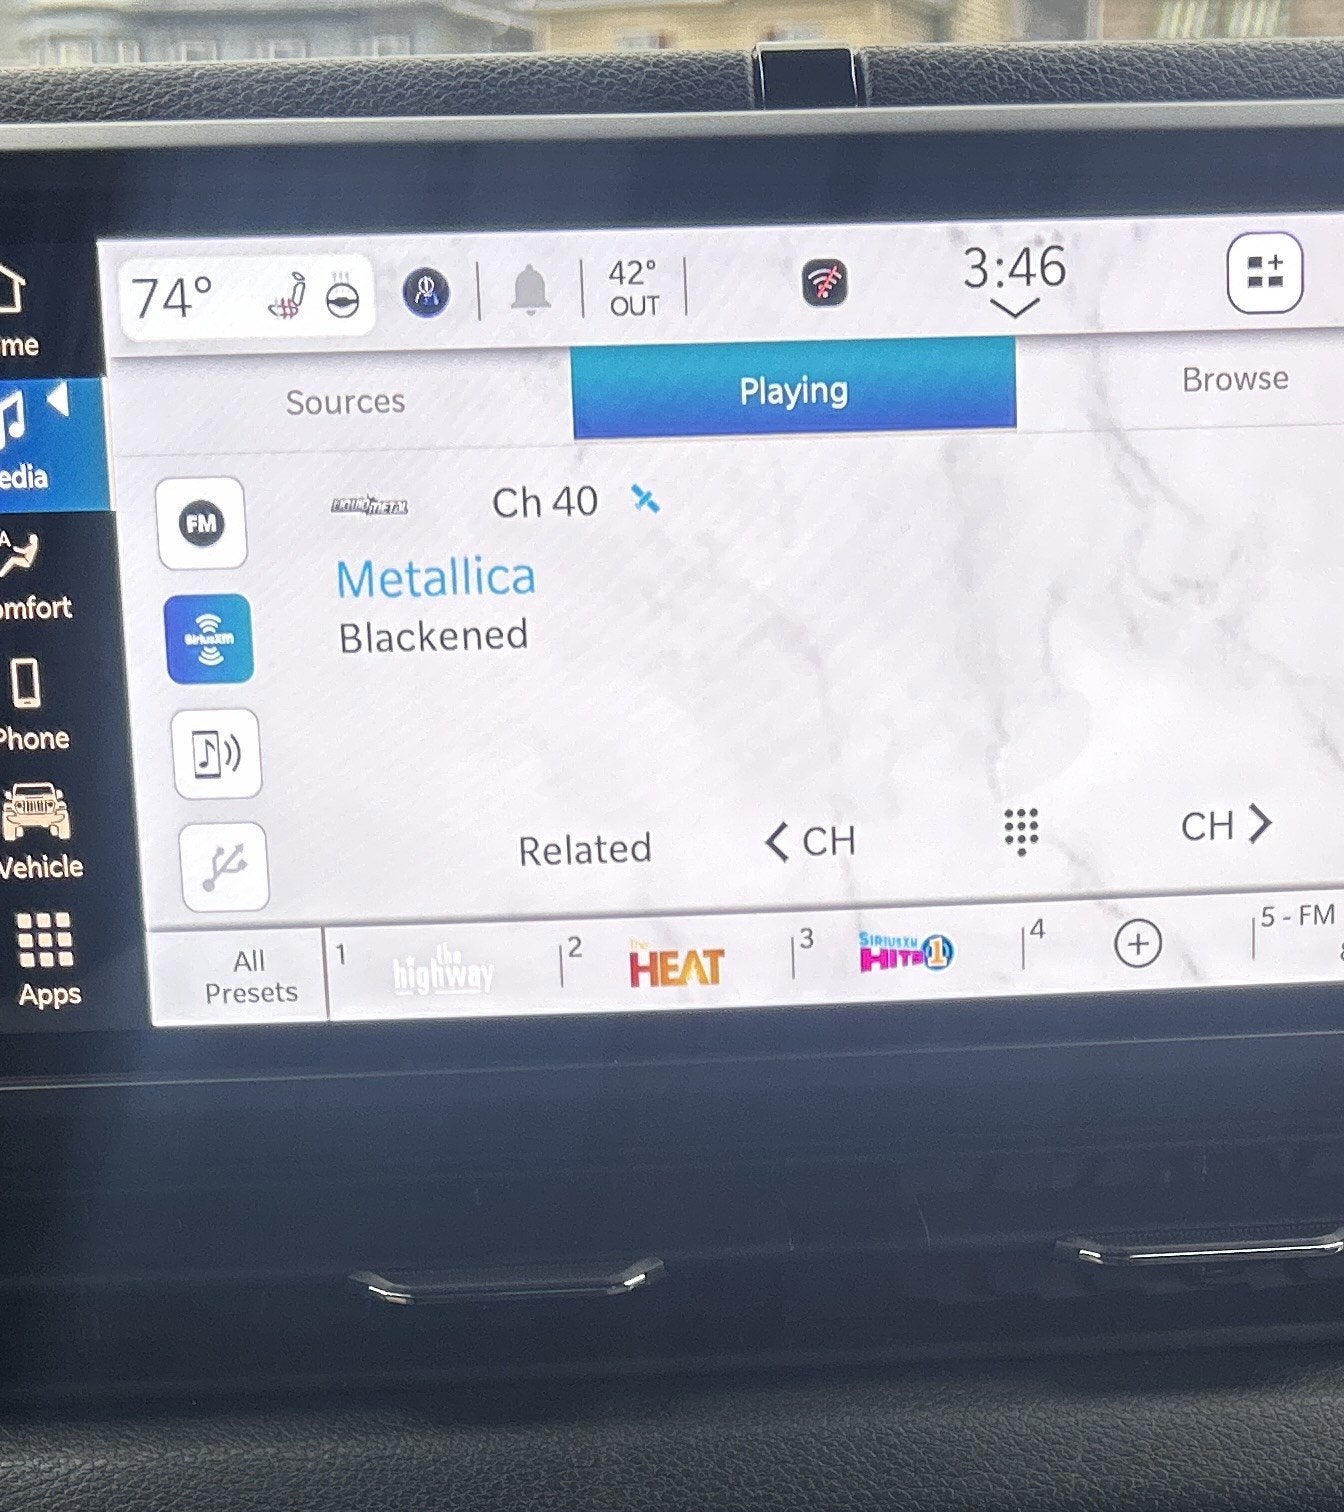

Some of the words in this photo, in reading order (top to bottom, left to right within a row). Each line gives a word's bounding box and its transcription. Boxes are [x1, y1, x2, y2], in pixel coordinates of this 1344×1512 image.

[608, 259, 656, 286] 42°
[964, 244, 1066, 289] 3:46
[131, 275, 212, 319] 74°
[610, 294, 661, 317] OUT
[740, 374, 848, 411] Playing
[1183, 366, 1289, 393] Browse
[286, 389, 406, 416] Sources
[492, 485, 541, 519] Ch
[552, 485, 598, 517] 40
[183, 510, 219, 537] FM
[337, 554, 536, 599] Metallica
[340, 616, 528, 654] Blackened
[1181, 810, 1233, 842] CH
[519, 831, 651, 867] Related
[802, 825, 855, 857] CH
[1029, 918, 1046, 939] 4
[1260, 905, 1275, 928] 5
[1299, 903, 1335, 926] FM
[567, 935, 583, 958] 2
[799, 927, 815, 950] 3
[233, 948, 265, 973] All
[336, 943, 345, 965] 1
[390, 954, 498, 997] highway
[628, 946, 726, 990] HEAT
[18, 983, 82, 1011] Apps
[205, 981, 299, 1005] Presets
